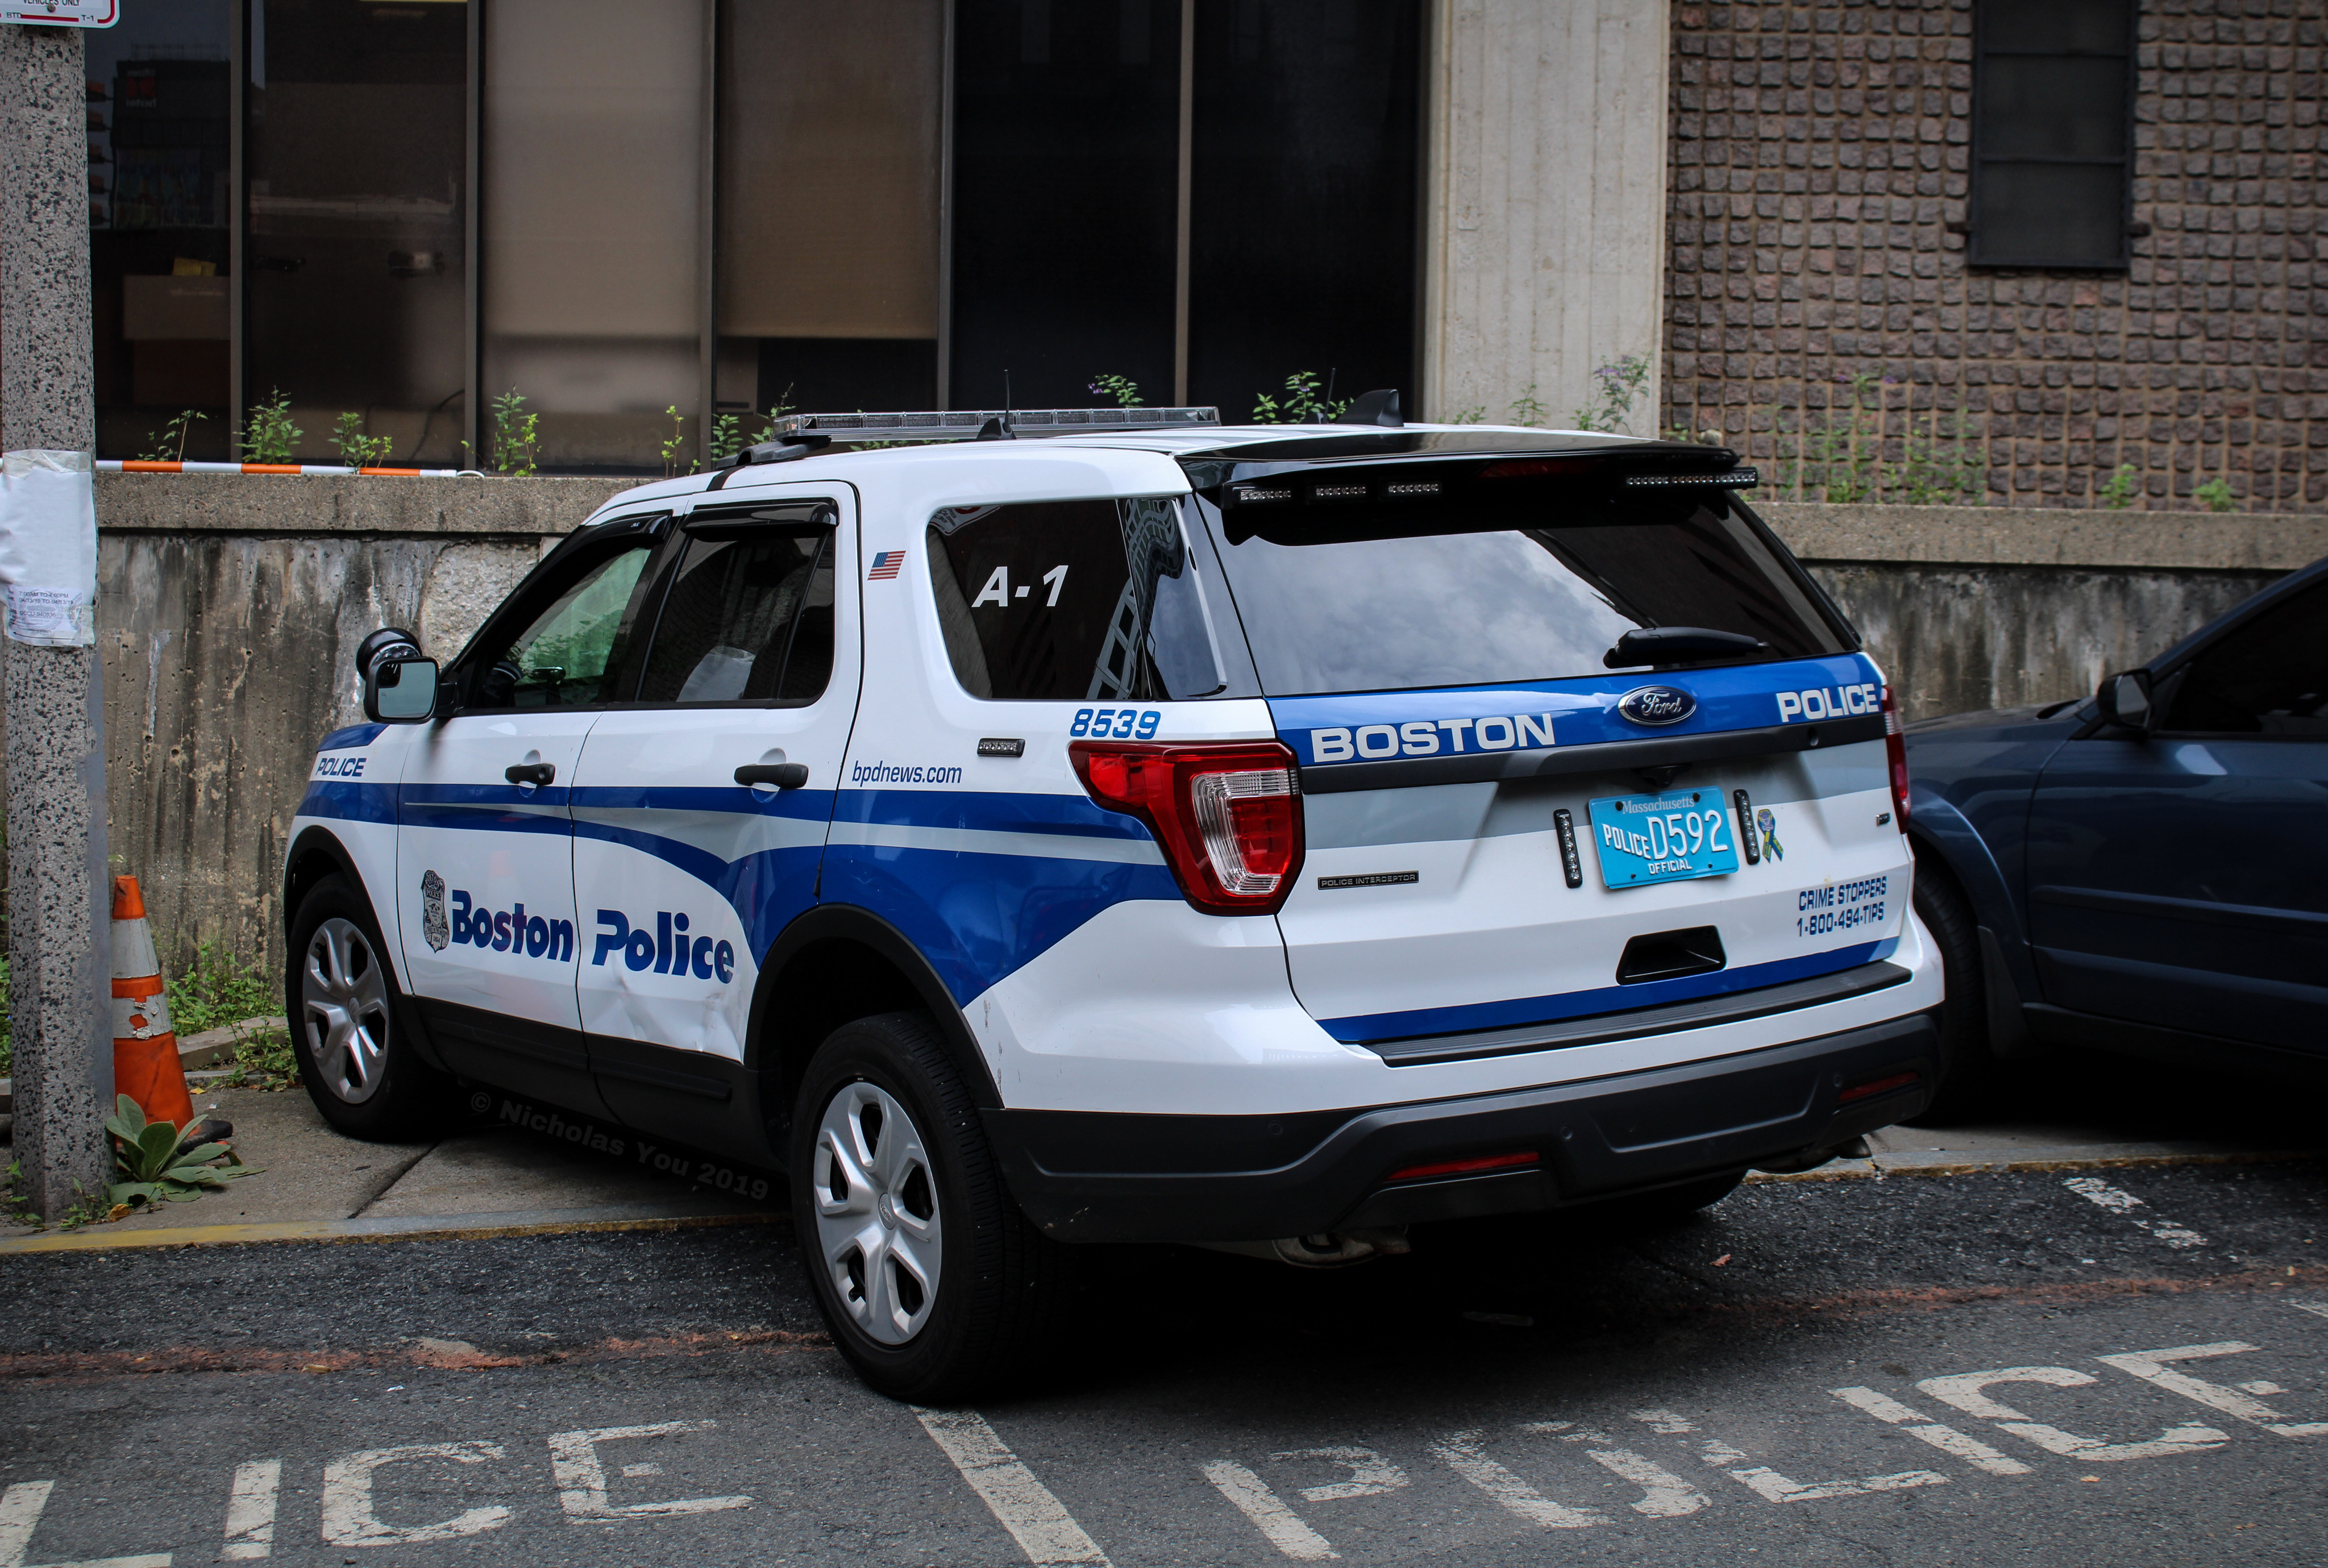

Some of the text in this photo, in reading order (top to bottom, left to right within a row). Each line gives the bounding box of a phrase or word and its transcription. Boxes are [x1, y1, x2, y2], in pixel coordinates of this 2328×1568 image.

[971, 565, 1069, 608] A-1
[1641, 692, 1682, 716] Ford
[1776, 683, 1879, 722] POLICE
[1070, 709, 1161, 739] 8539
[1311, 713, 1556, 763] BOSTON
[315, 758, 367, 777] POLICE
[852, 760, 962, 787] bpdnews.com
[1623, 797, 1695, 814] Massachusetts
[1602, 810, 1728, 860] POLICE D592
[1356, 874, 1415, 884] INTERCEPTOR
[1649, 859, 1693, 875] OFFICIAL
[1799, 876, 1887, 911] CRIME STOPPERS
[1797, 901, 1884, 937] 1-800-494-TIPS
[451, 889, 734, 984] Boston Police
